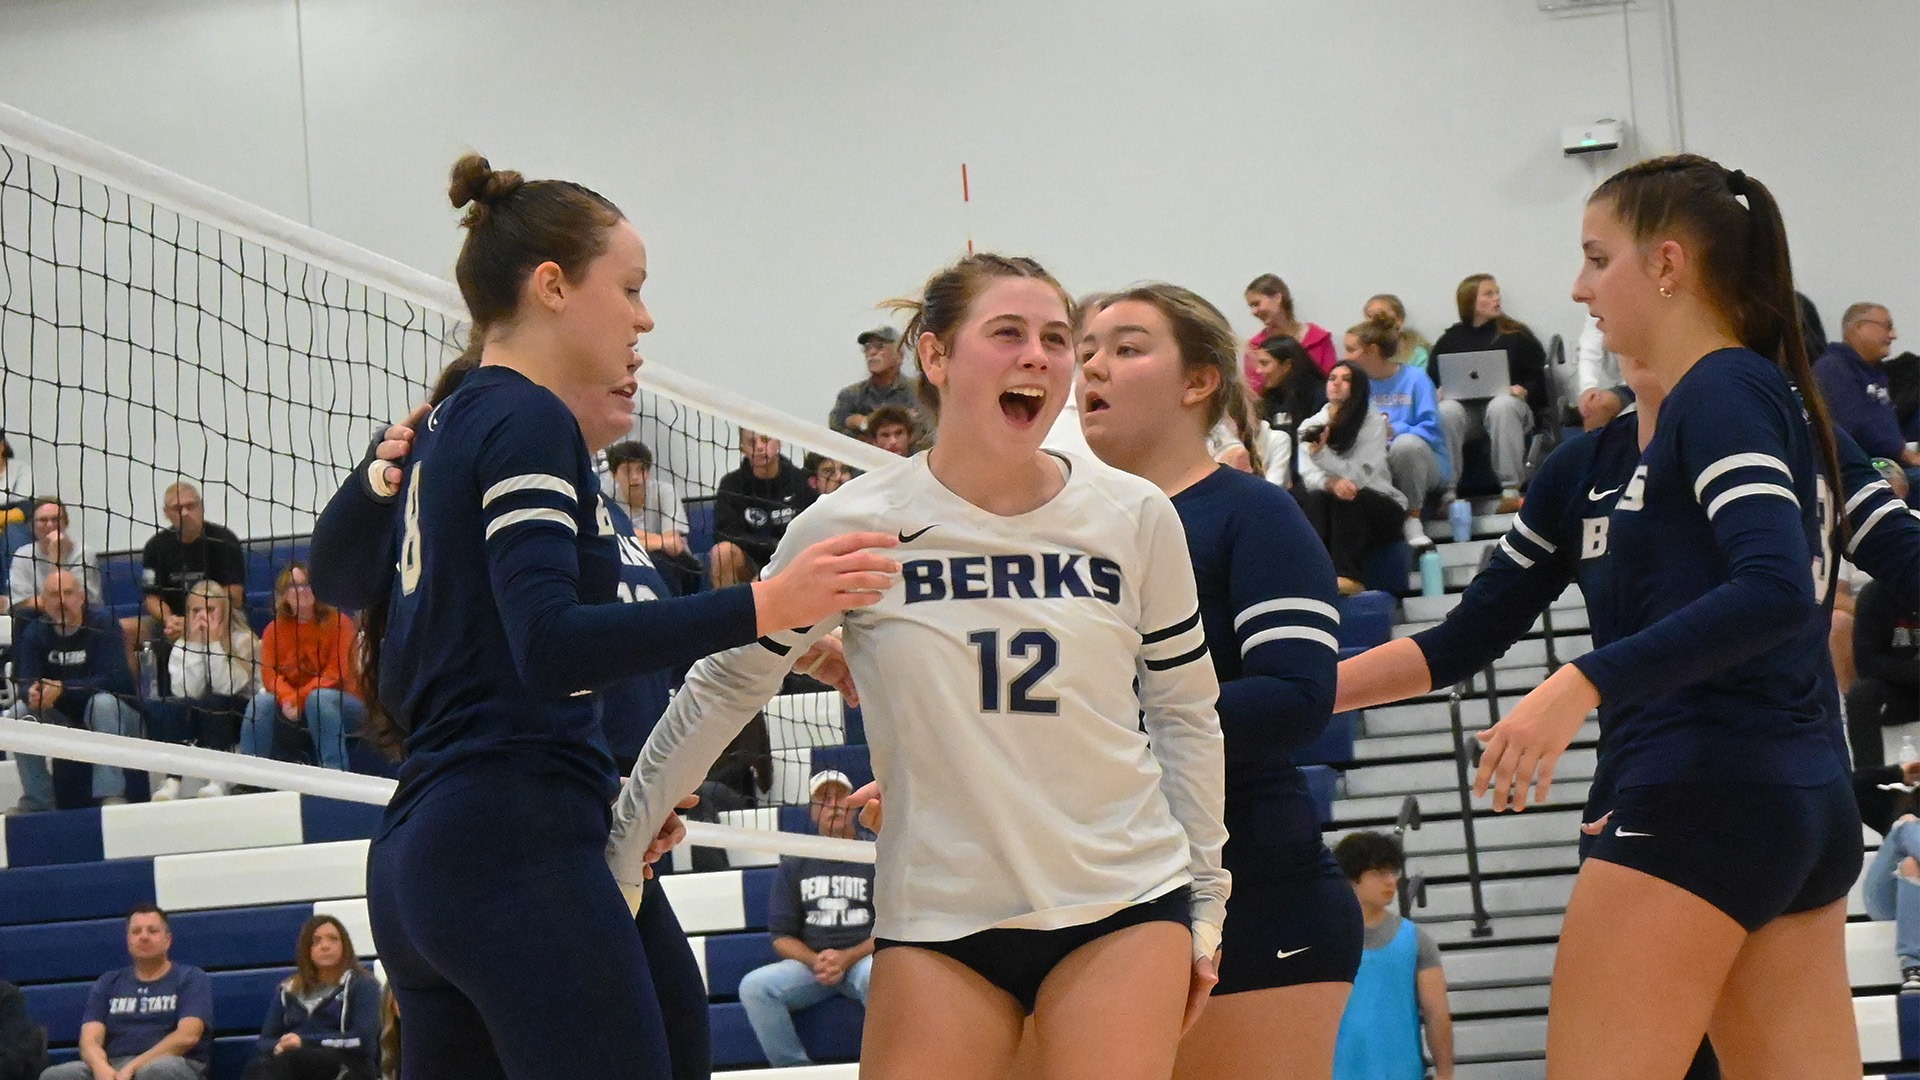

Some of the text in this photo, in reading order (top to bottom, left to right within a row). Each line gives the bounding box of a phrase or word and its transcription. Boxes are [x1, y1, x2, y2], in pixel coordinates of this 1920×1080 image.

[401, 460, 422, 597] 8
[902, 553, 1122, 606] BERKS
[966, 627, 1061, 717] 12
